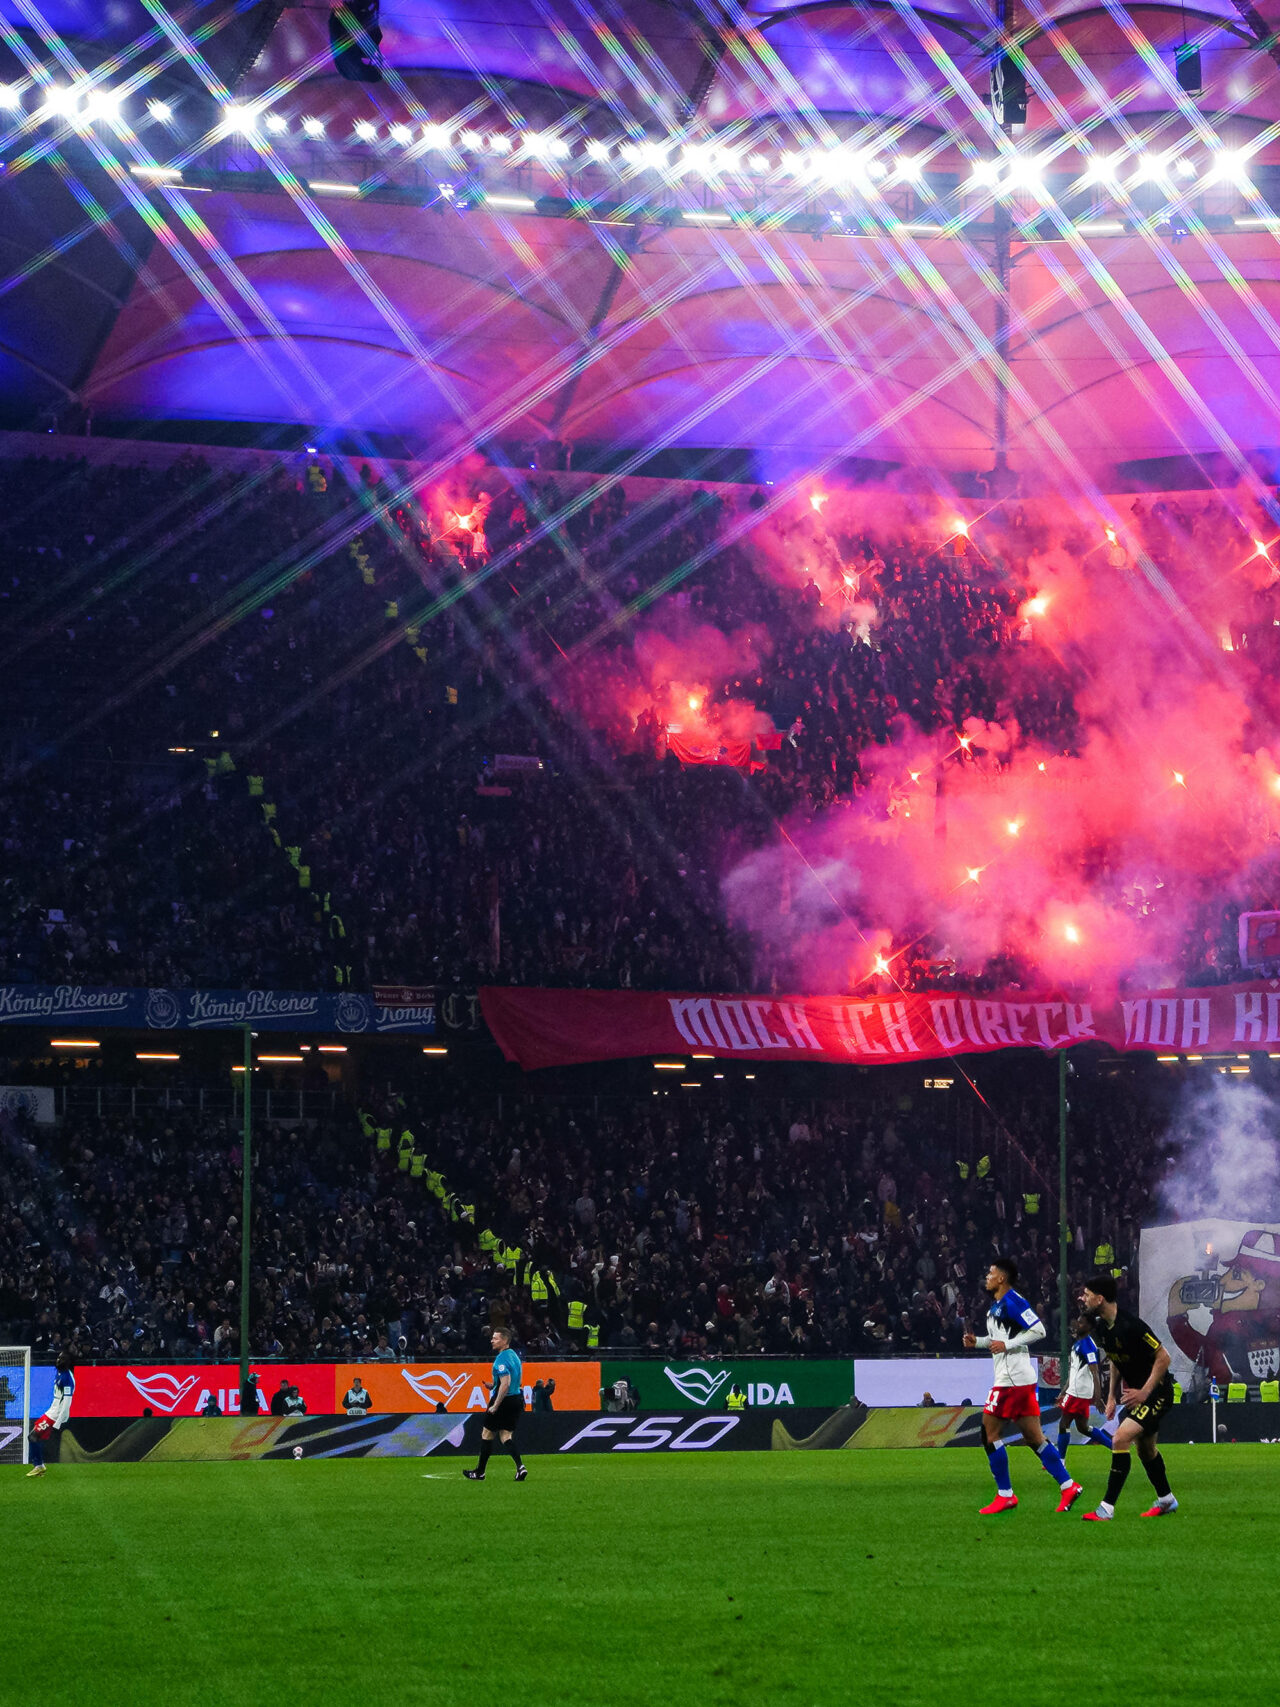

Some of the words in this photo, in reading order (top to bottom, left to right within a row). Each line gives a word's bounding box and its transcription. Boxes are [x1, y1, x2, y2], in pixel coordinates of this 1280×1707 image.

[53, 985, 128, 1011] Pilsener
[187, 990, 246, 1020] König
[834, 1002, 920, 1054] ICH
[929, 998, 1097, 1049] DIRECK
[732, 1383, 795, 1405] IDA
[559, 1416, 740, 1450] F50
